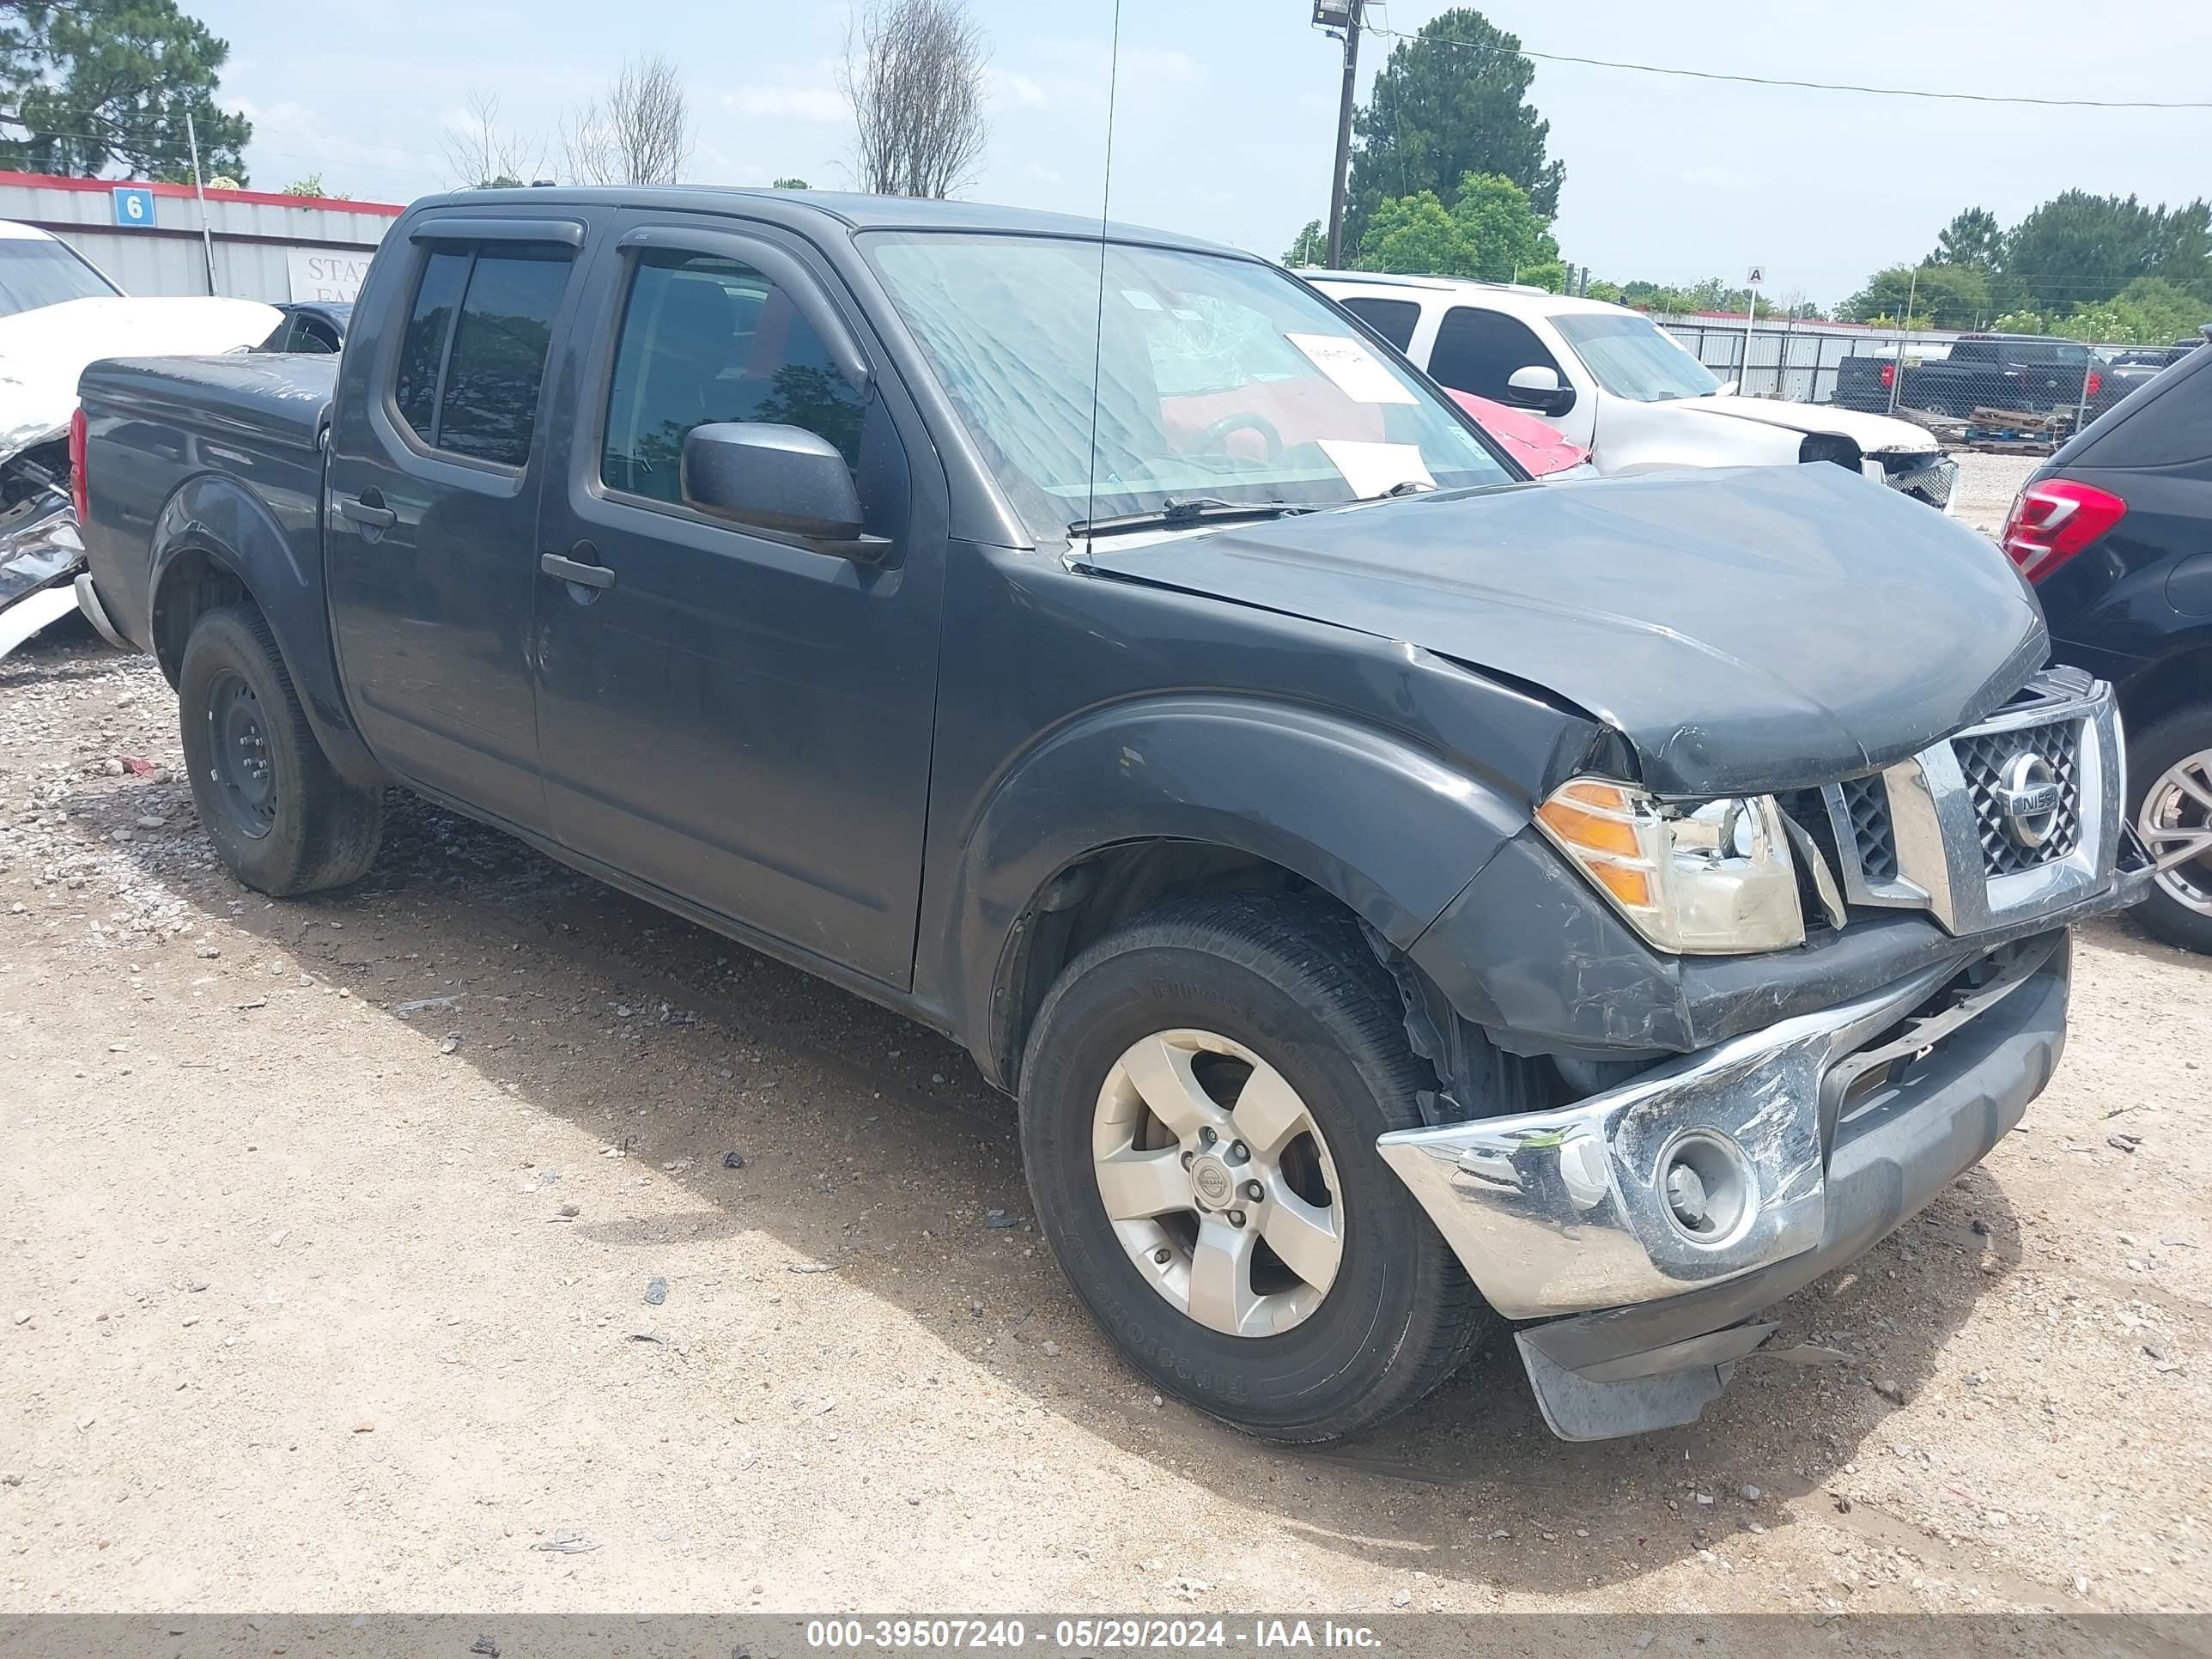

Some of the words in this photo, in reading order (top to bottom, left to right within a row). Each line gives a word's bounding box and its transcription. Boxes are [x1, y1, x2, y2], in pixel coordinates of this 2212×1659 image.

[126, 195, 143, 219] 6
[1750, 269, 1761, 281] A
[2022, 792, 2058, 811] NISSA
